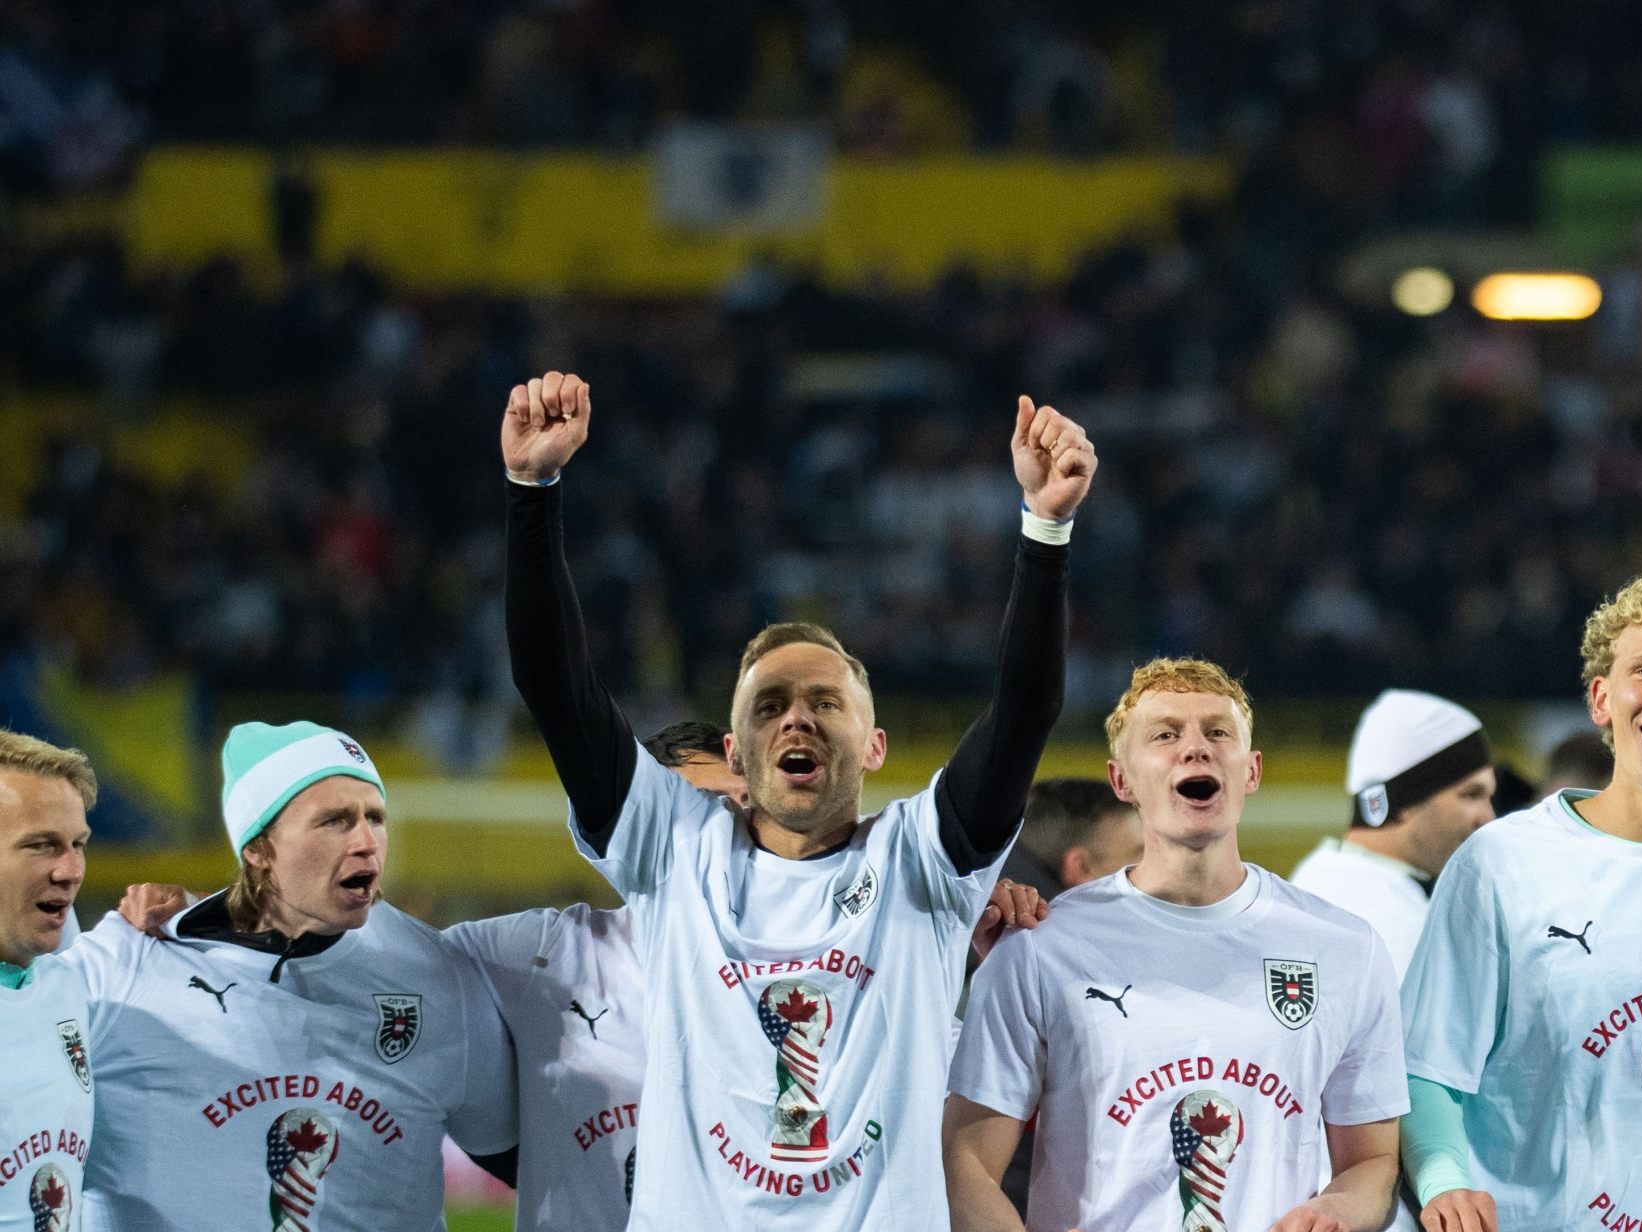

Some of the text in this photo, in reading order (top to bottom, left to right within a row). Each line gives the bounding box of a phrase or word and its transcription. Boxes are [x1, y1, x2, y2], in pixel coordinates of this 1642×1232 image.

[202, 1074, 404, 1146] EXCITED ABOUT
[1106, 1056, 1304, 1127] EXCITED ABOUT
[0, 1128, 88, 1188] CITED ABO
[574, 1103, 638, 1152] EXCIT
[709, 1119, 883, 1197] PLAYING UNITED
